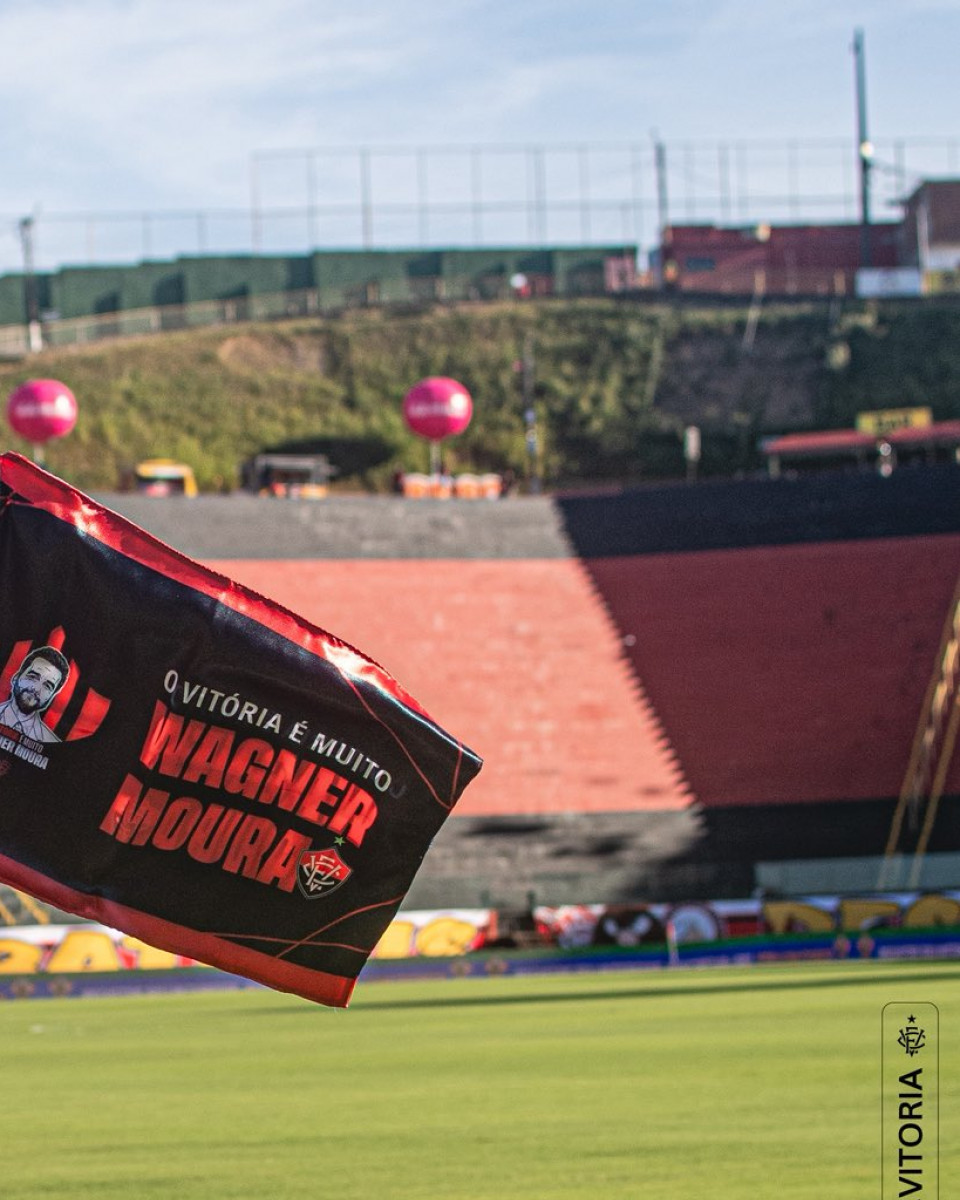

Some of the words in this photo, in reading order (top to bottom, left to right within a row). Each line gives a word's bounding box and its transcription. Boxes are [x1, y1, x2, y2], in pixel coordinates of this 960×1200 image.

[14, 744, 49, 770] MOURA
[140, 699, 379, 848] WAGNER
[163, 670, 179, 693] O
[182, 680, 283, 734] VITÓRIA
[288, 720, 309, 744] É
[311, 733, 393, 793] MUITO
[99, 773, 313, 893] MOURA
